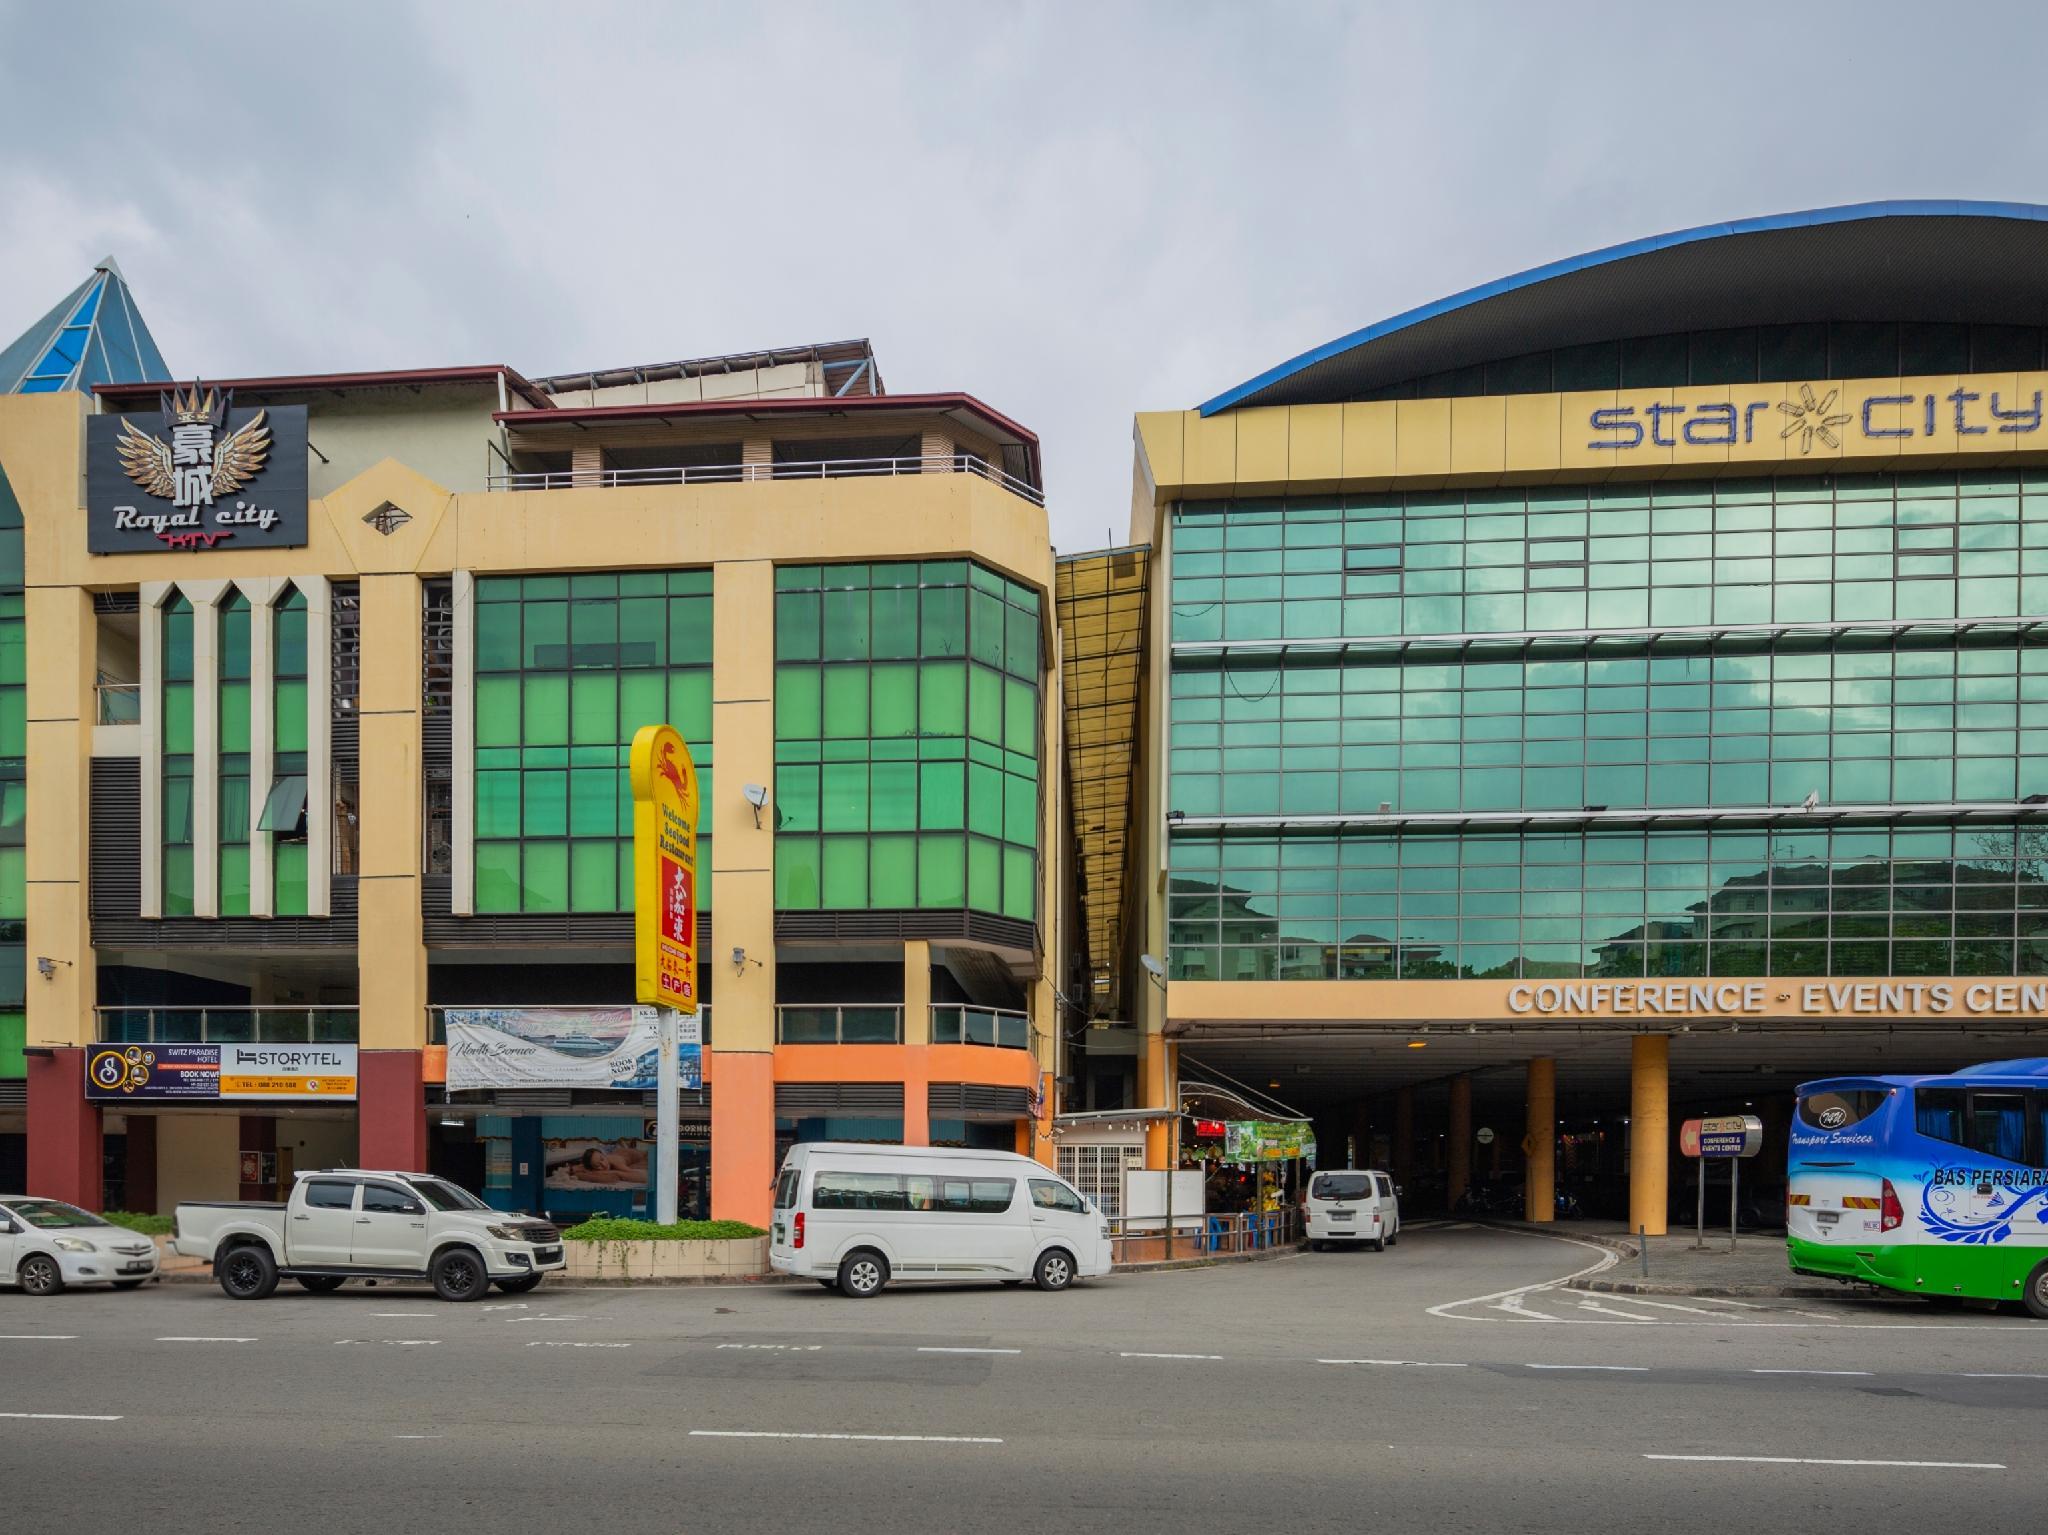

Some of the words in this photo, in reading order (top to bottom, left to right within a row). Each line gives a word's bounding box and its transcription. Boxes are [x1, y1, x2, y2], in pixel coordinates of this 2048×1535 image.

[1588, 401, 1769, 449] star
[1862, 386, 2043, 438] city
[113, 505, 200, 534] Royal
[215, 501, 279, 529] city
[156, 531, 233, 547] KTV
[662, 802, 690, 833] Welcome
[664, 821, 690, 849] Seafood
[660, 834, 694, 867] Restaurant
[1508, 982, 1767, 1013] CONFERENCE
[1803, 983, 1954, 1013] EVENTS
[168, 1048, 188, 1056] SWITZ
[188, 1048, 219, 1056] PARADISE
[450, 1042, 489, 1057] North
[489, 1042, 537, 1057] Borneo
[258, 1052, 341, 1065] STORYTEL
[180, 1070, 200, 1078] BOOK
[1703, 1136, 1735, 1144] CONFERENCE
[1791, 1132, 1829, 1146] Transport
[1830, 1131, 1873, 1144] Services
[1702, 1144, 1720, 1152] EVENTS
[1721, 1144, 1741, 1152] CENTRE
[1934, 1167, 1966, 1186] BAS
